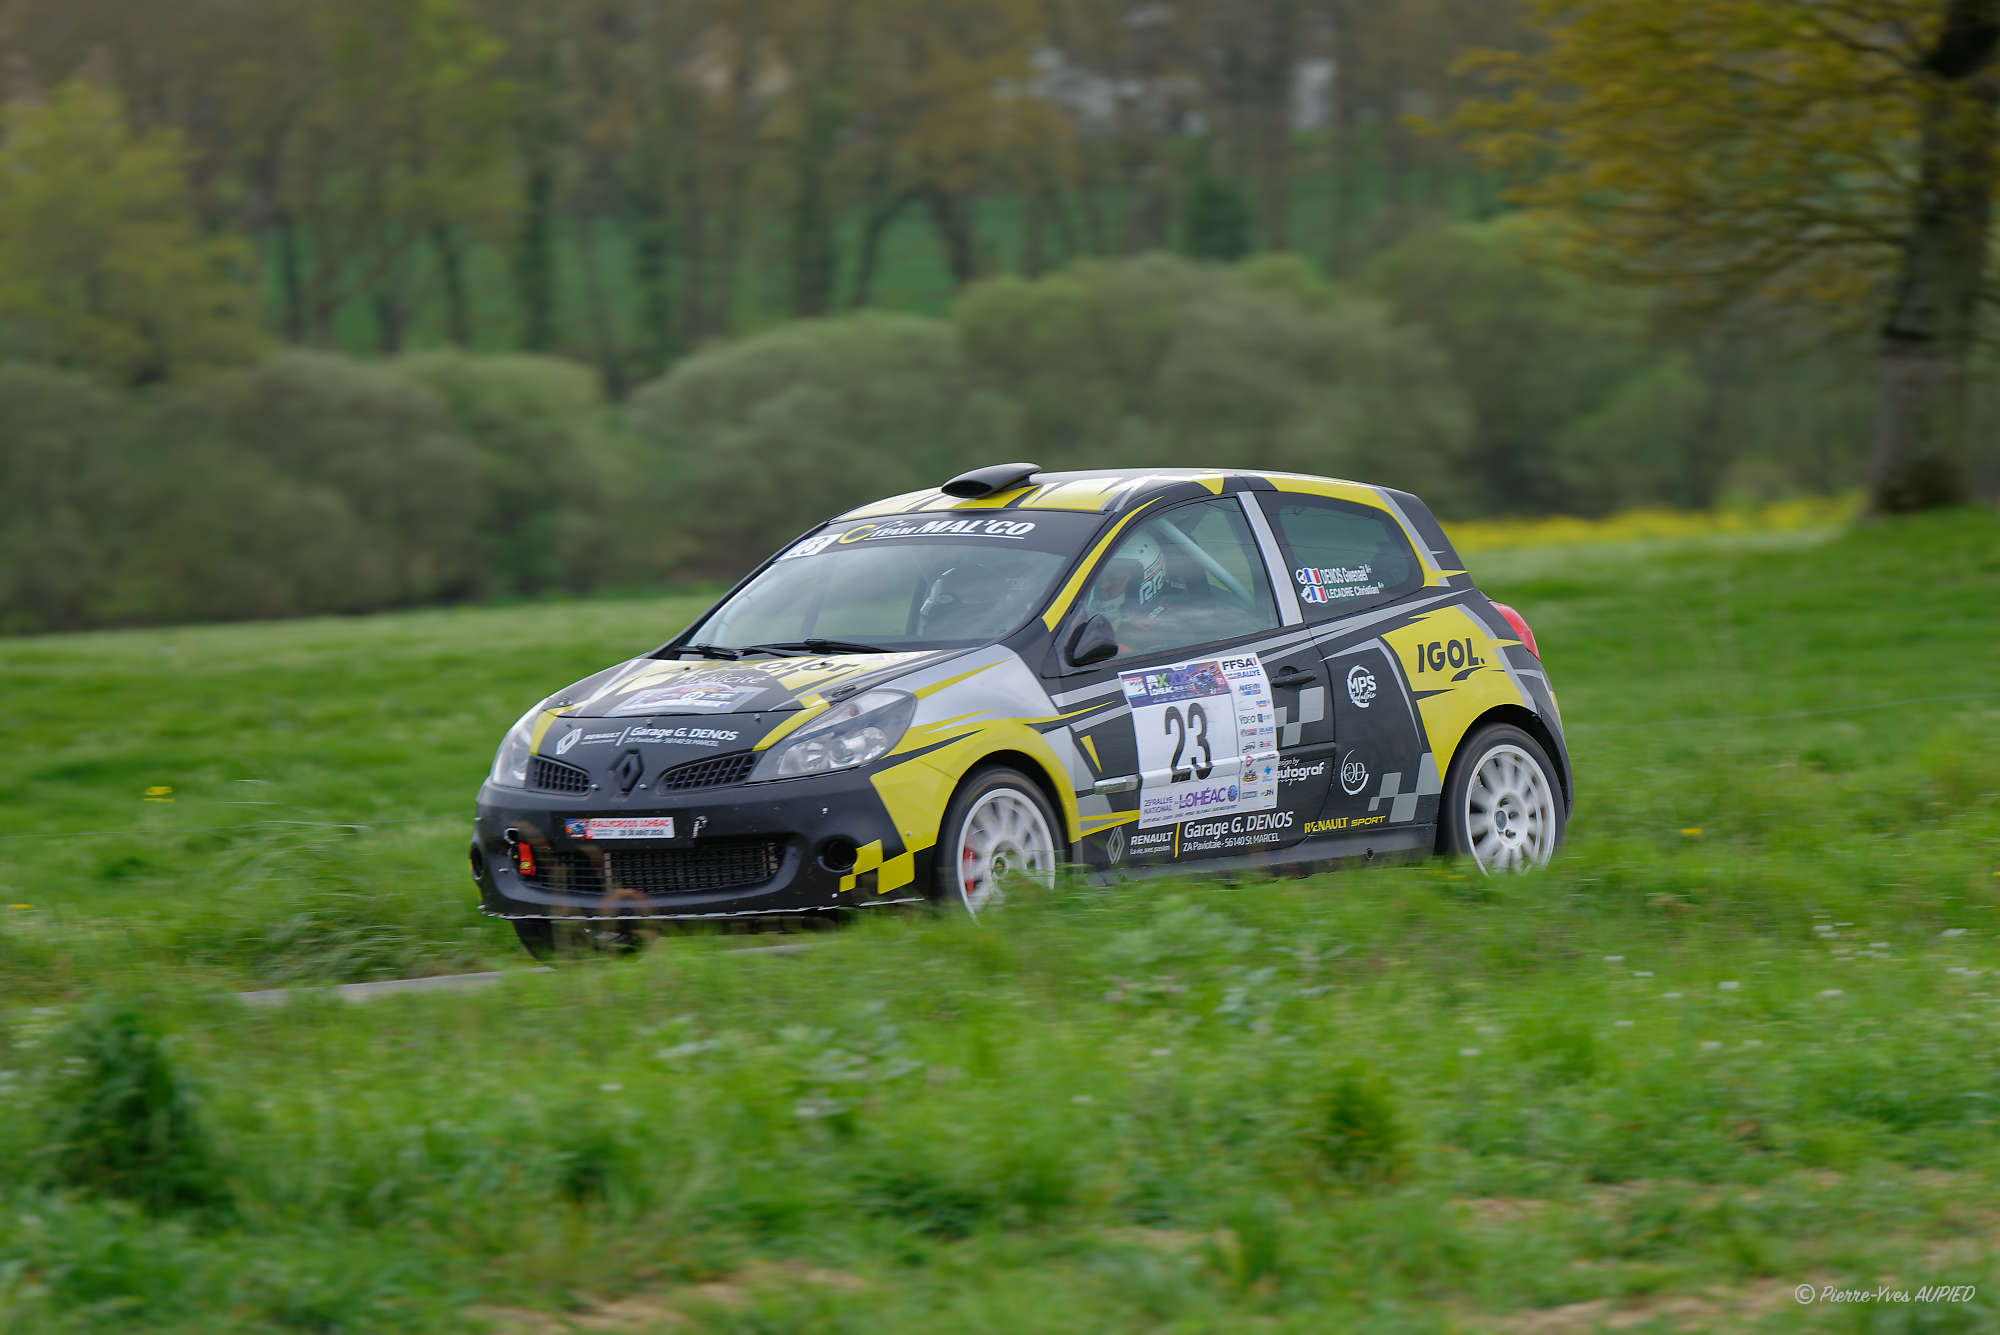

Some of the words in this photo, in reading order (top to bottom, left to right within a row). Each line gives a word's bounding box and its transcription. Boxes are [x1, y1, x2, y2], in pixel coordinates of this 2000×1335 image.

[917, 519, 1036, 536] MAL'CO
[1320, 568, 1343, 584] DENOS
[1354, 585, 1380, 596] Christian
[1237, 669, 1261, 678] RALLYE
[1351, 675, 1376, 696] MPS
[630, 727, 673, 739] Garage
[687, 728, 740, 741] DENOS
[1165, 703, 1213, 783] 23
[1179, 787, 1226, 809] LOHÉAC
[1184, 821, 1228, 839] Garage
[1231, 817, 1244, 833] G.
[1246, 811, 1294, 832] DENOS
[1304, 817, 1349, 833] RENAULT
[1351, 816, 1386, 827] SPORT
[1131, 832, 1173, 846] RENAULT
[1183, 842, 1193, 852] ZA
[1253, 832, 1280, 844] MARCEL
